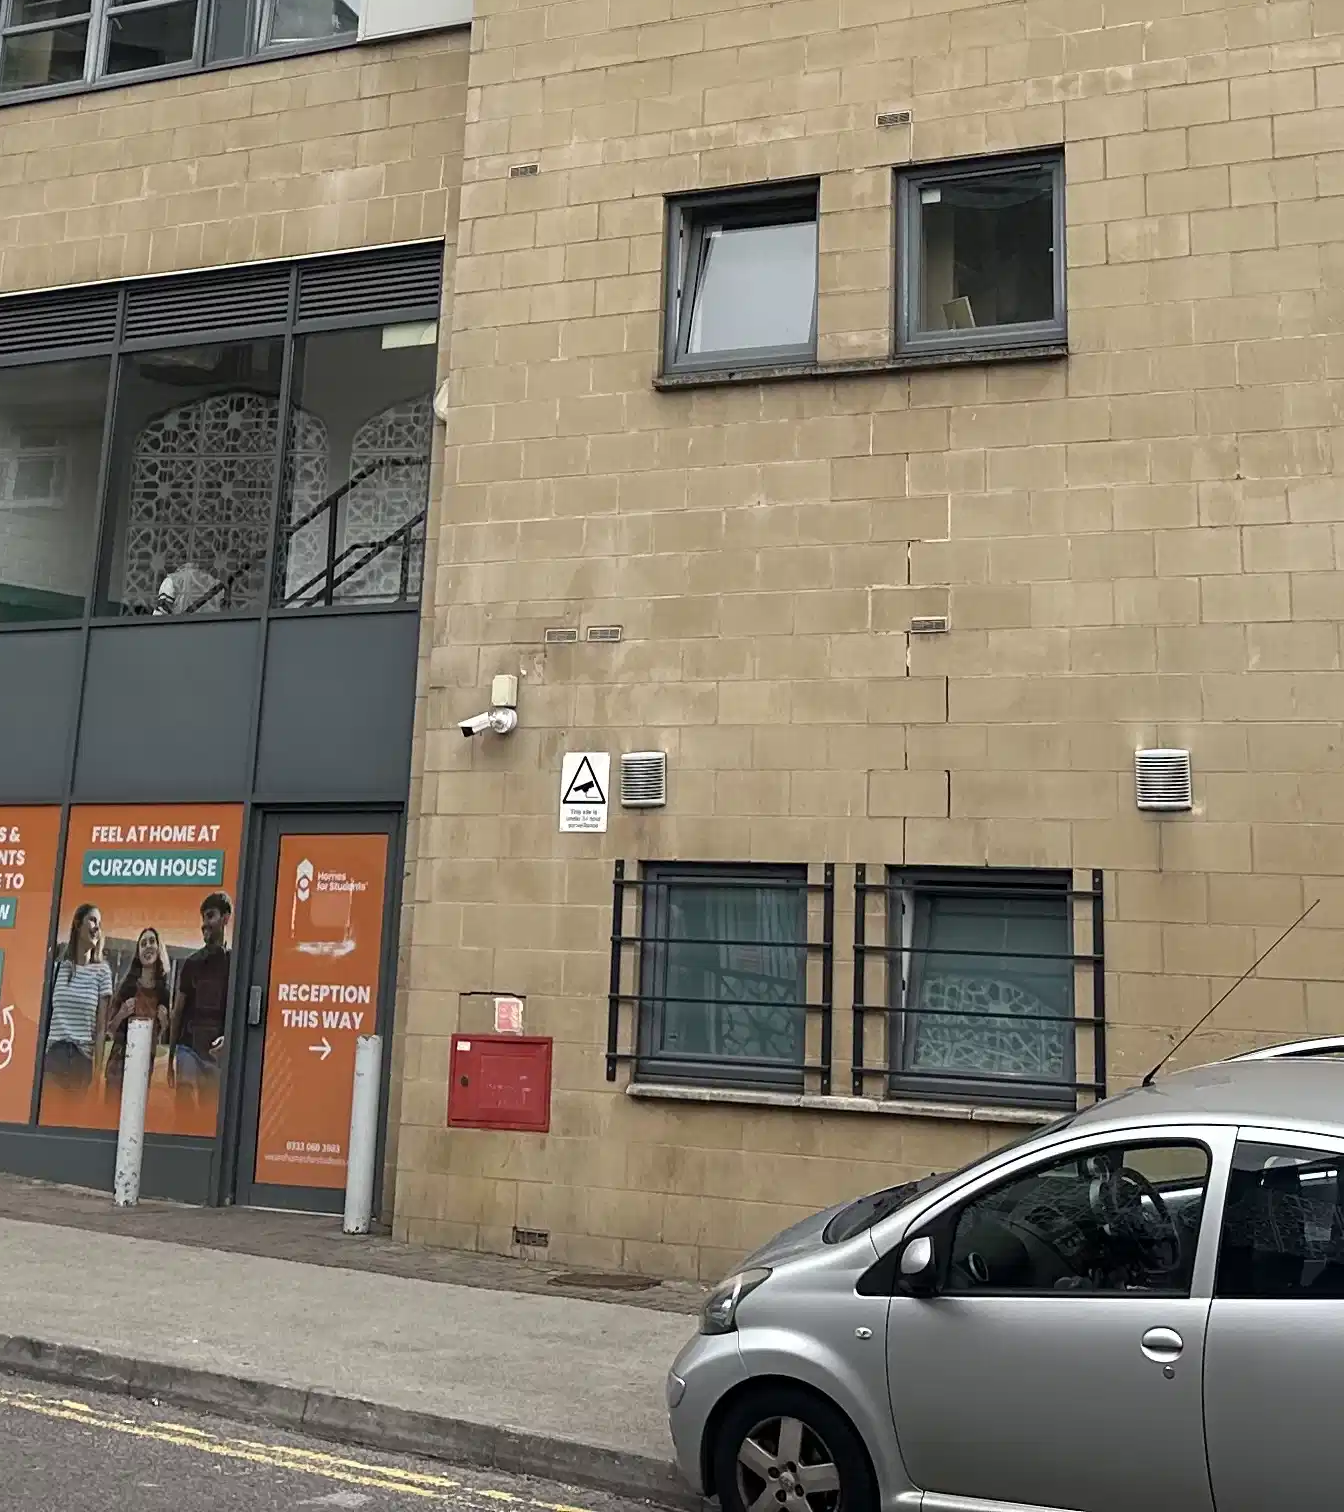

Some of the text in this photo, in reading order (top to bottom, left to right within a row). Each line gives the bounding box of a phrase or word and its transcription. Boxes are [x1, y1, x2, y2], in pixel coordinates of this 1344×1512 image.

[9, 826, 20, 843] &
[91, 824, 221, 843] FEEL AT HOME AT
[88, 858, 218, 877] CURZON HOUSE
[4, 873, 25, 889] TO
[277, 983, 371, 1004] RECEPTION
[281, 1009, 364, 1030] THIS WAY
